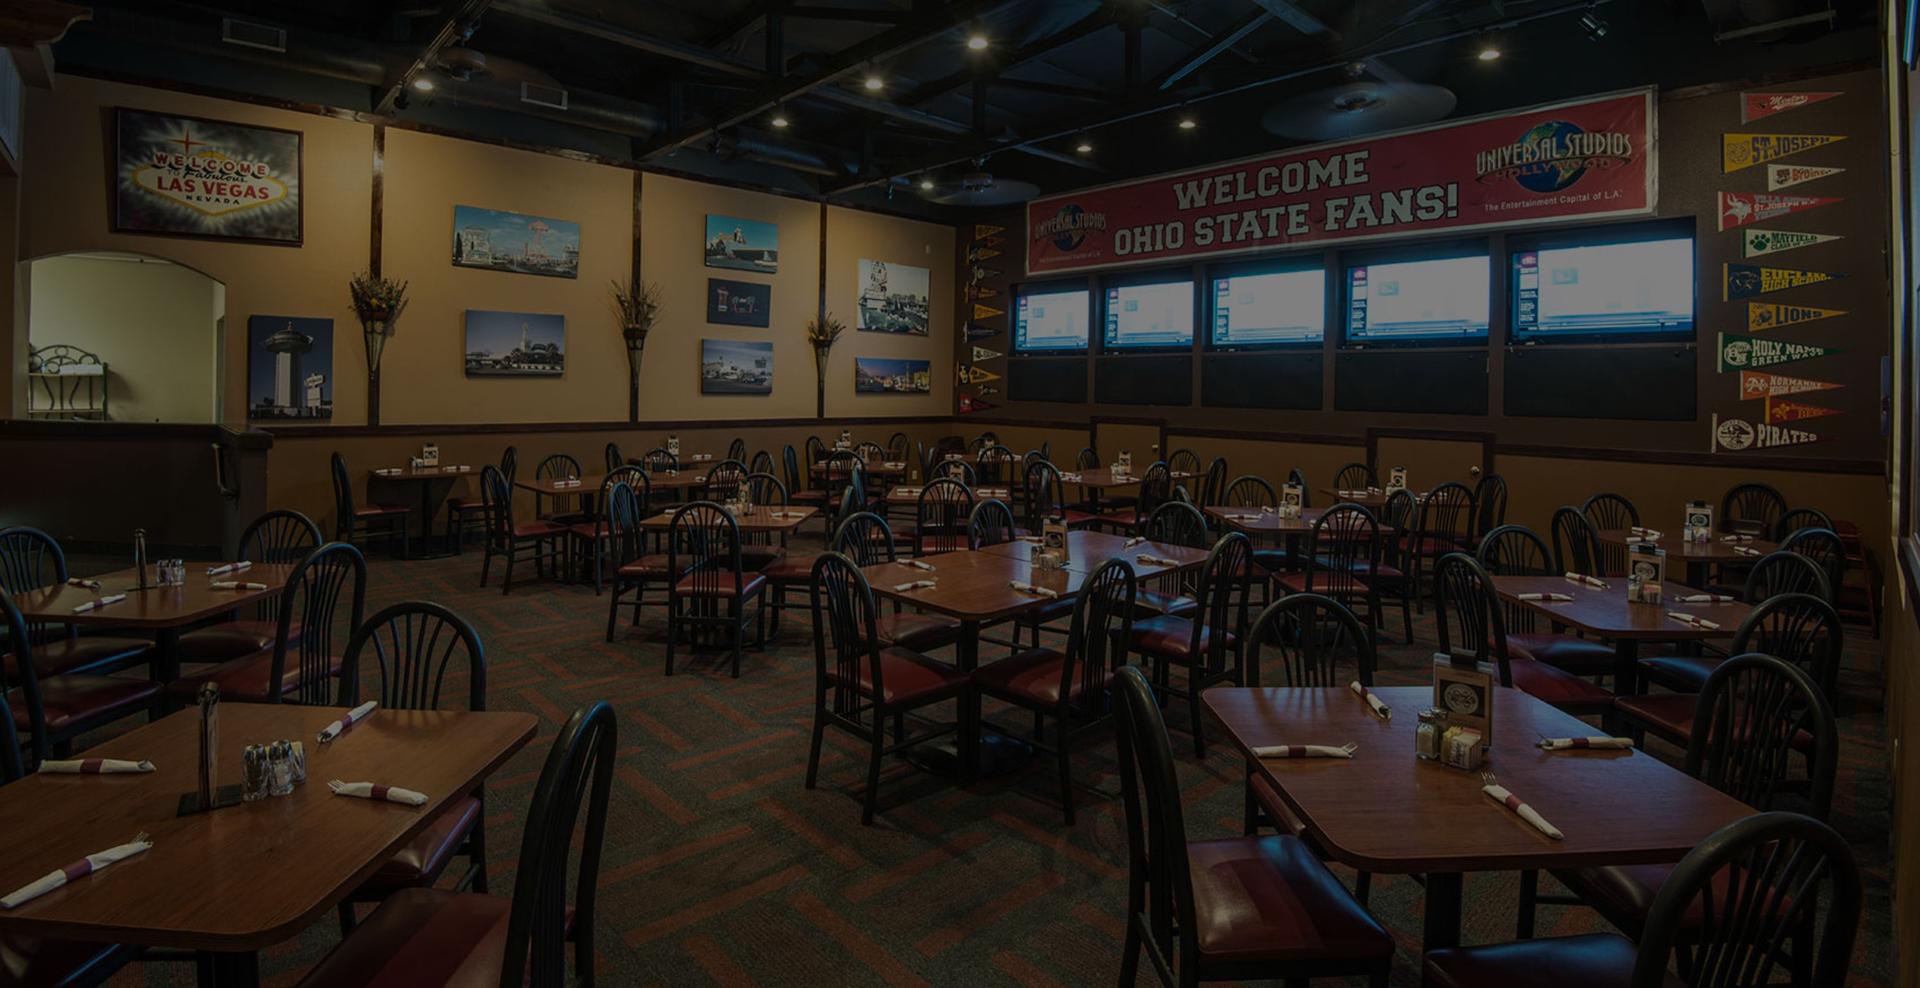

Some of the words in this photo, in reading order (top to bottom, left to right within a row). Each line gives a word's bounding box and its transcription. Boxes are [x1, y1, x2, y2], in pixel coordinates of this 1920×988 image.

[154, 152, 267, 176] WELCOME
[1476, 138, 1562, 175] UNIVERSAL
[1565, 132, 1633, 158] STUDIOS
[156, 176, 196, 193] LAS
[202, 181, 270, 200] VEGAS
[1172, 148, 1369, 211] WELCOME
[186, 194, 241, 205] NEVADA
[1485, 203, 1499, 212] The
[1501, 197, 1557, 210] Entertainment
[1560, 192, 1590, 206] Capital
[1592, 192, 1602, 202] of
[1075, 212, 1107, 231] STUDIOS
[1113, 220, 1186, 257] OHIO
[1193, 202, 1311, 247] STATE
[1323, 181, 1459, 233] FANS!
[1751, 339, 1783, 357] HOLY
[1751, 354, 1788, 367] GREEN
[1757, 423, 1818, 449] PIRATES
